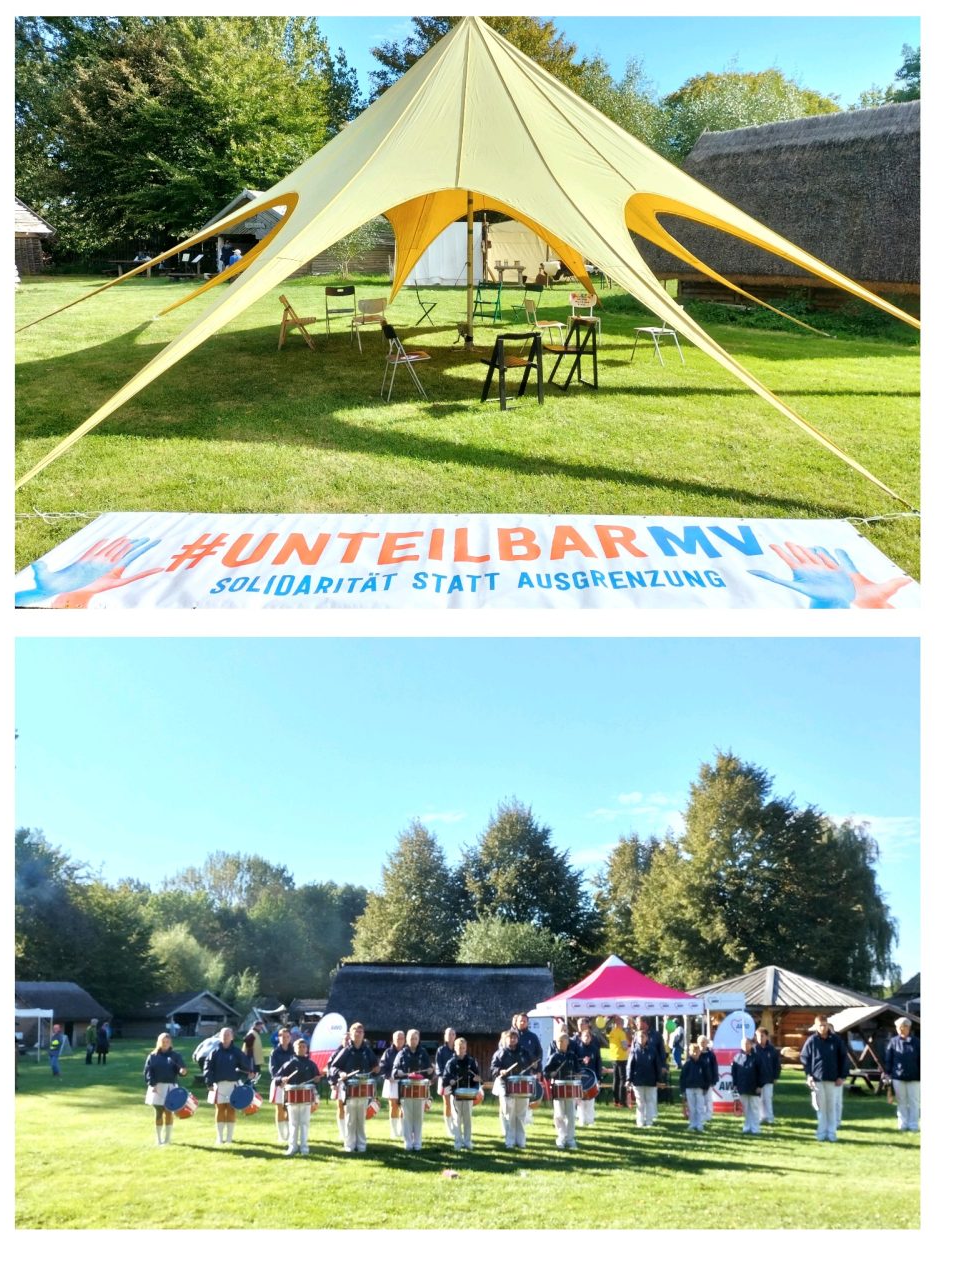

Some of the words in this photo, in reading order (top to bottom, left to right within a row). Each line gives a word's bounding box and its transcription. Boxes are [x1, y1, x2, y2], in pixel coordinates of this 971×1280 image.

[210, 572, 398, 596] SOLIDARITÄT
[412, 571, 500, 593] STATT
[517, 569, 727, 591] AUSGRENZUNG
[719, 1081, 733, 1091] AW
